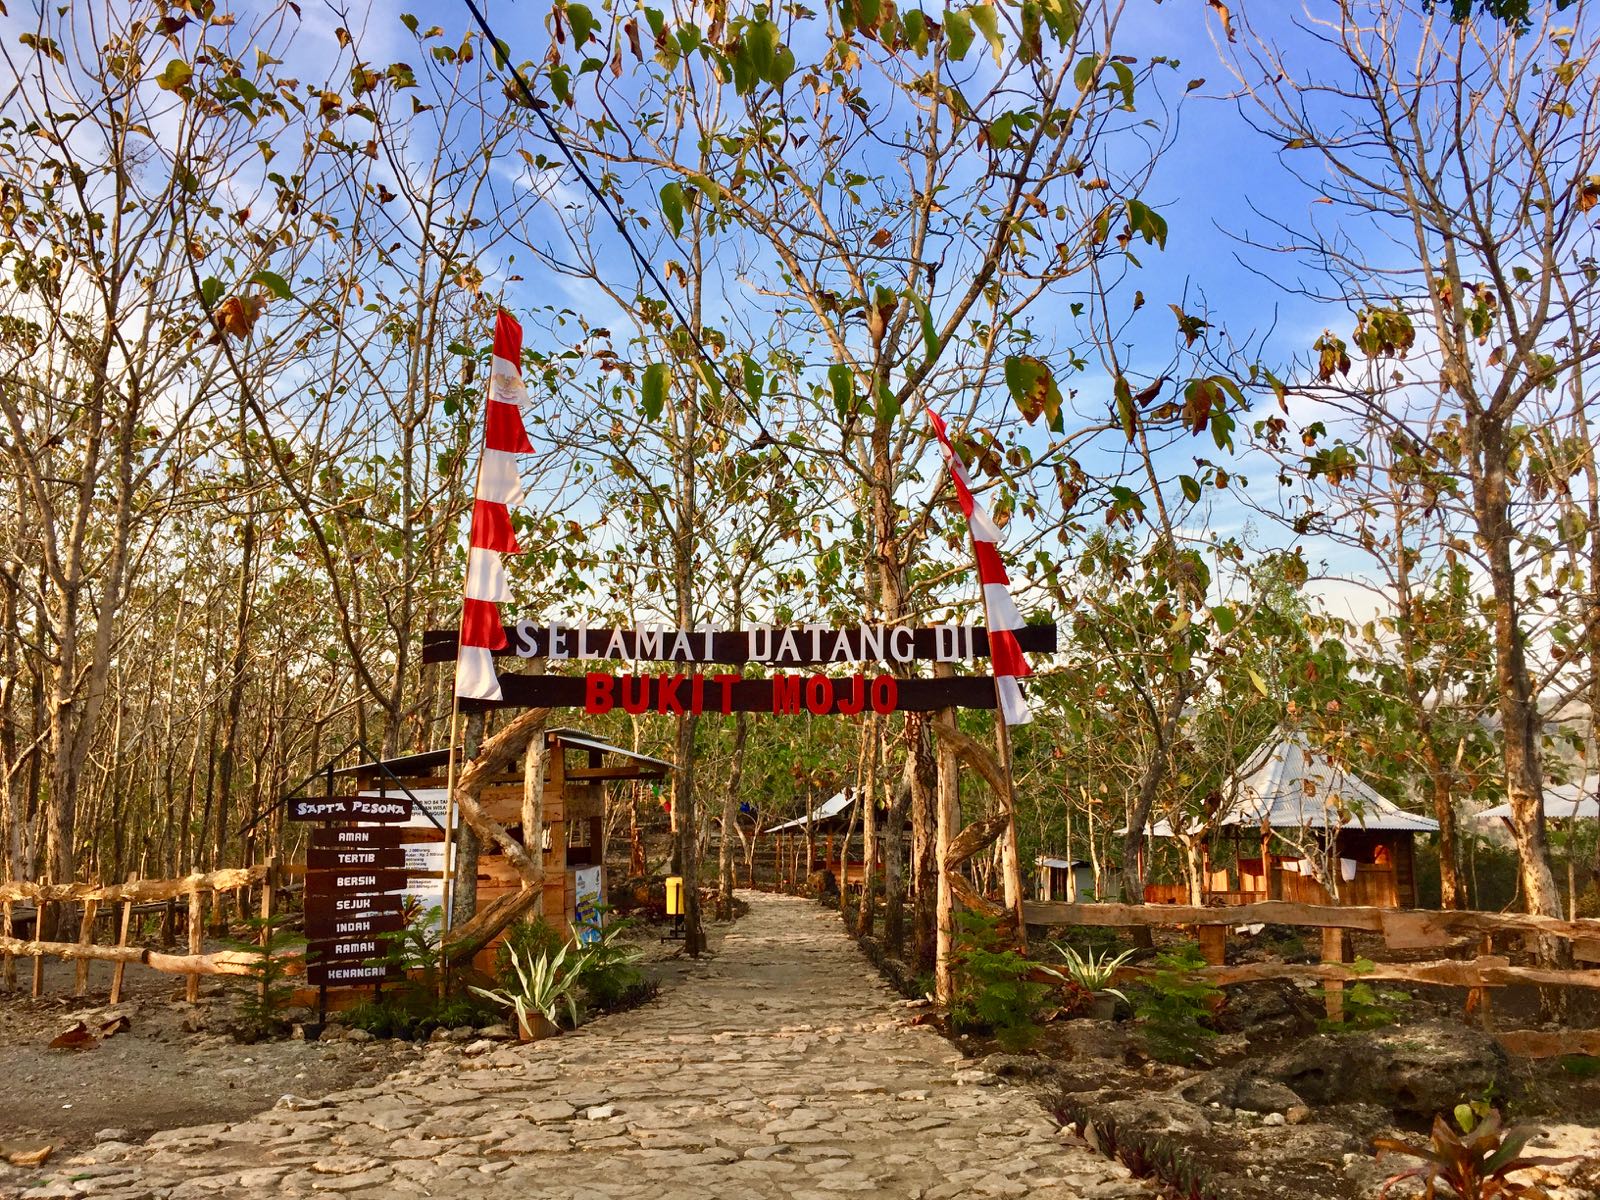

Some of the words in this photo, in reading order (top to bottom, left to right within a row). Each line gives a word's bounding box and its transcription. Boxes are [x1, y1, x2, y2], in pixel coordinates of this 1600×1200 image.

[516, 618, 723, 661] SELAMAT
[748, 622, 915, 663] DATANG
[934, 624, 975, 662] DI
[585, 672, 741, 716] BUKIT
[772, 673, 898, 716] MOJO
[297, 802, 346, 816] SAPTA
[352, 801, 406, 815] PESONA
[338, 832, 369, 842] AMAN
[338, 853, 375, 863] TERTIB
[337, 876, 376, 886] BERSIH
[336, 899, 371, 910] SEJUK
[336, 922, 370, 932] INDAH
[335, 942, 375, 954] RAMAH
[328, 967, 386, 979] KENANGAN
